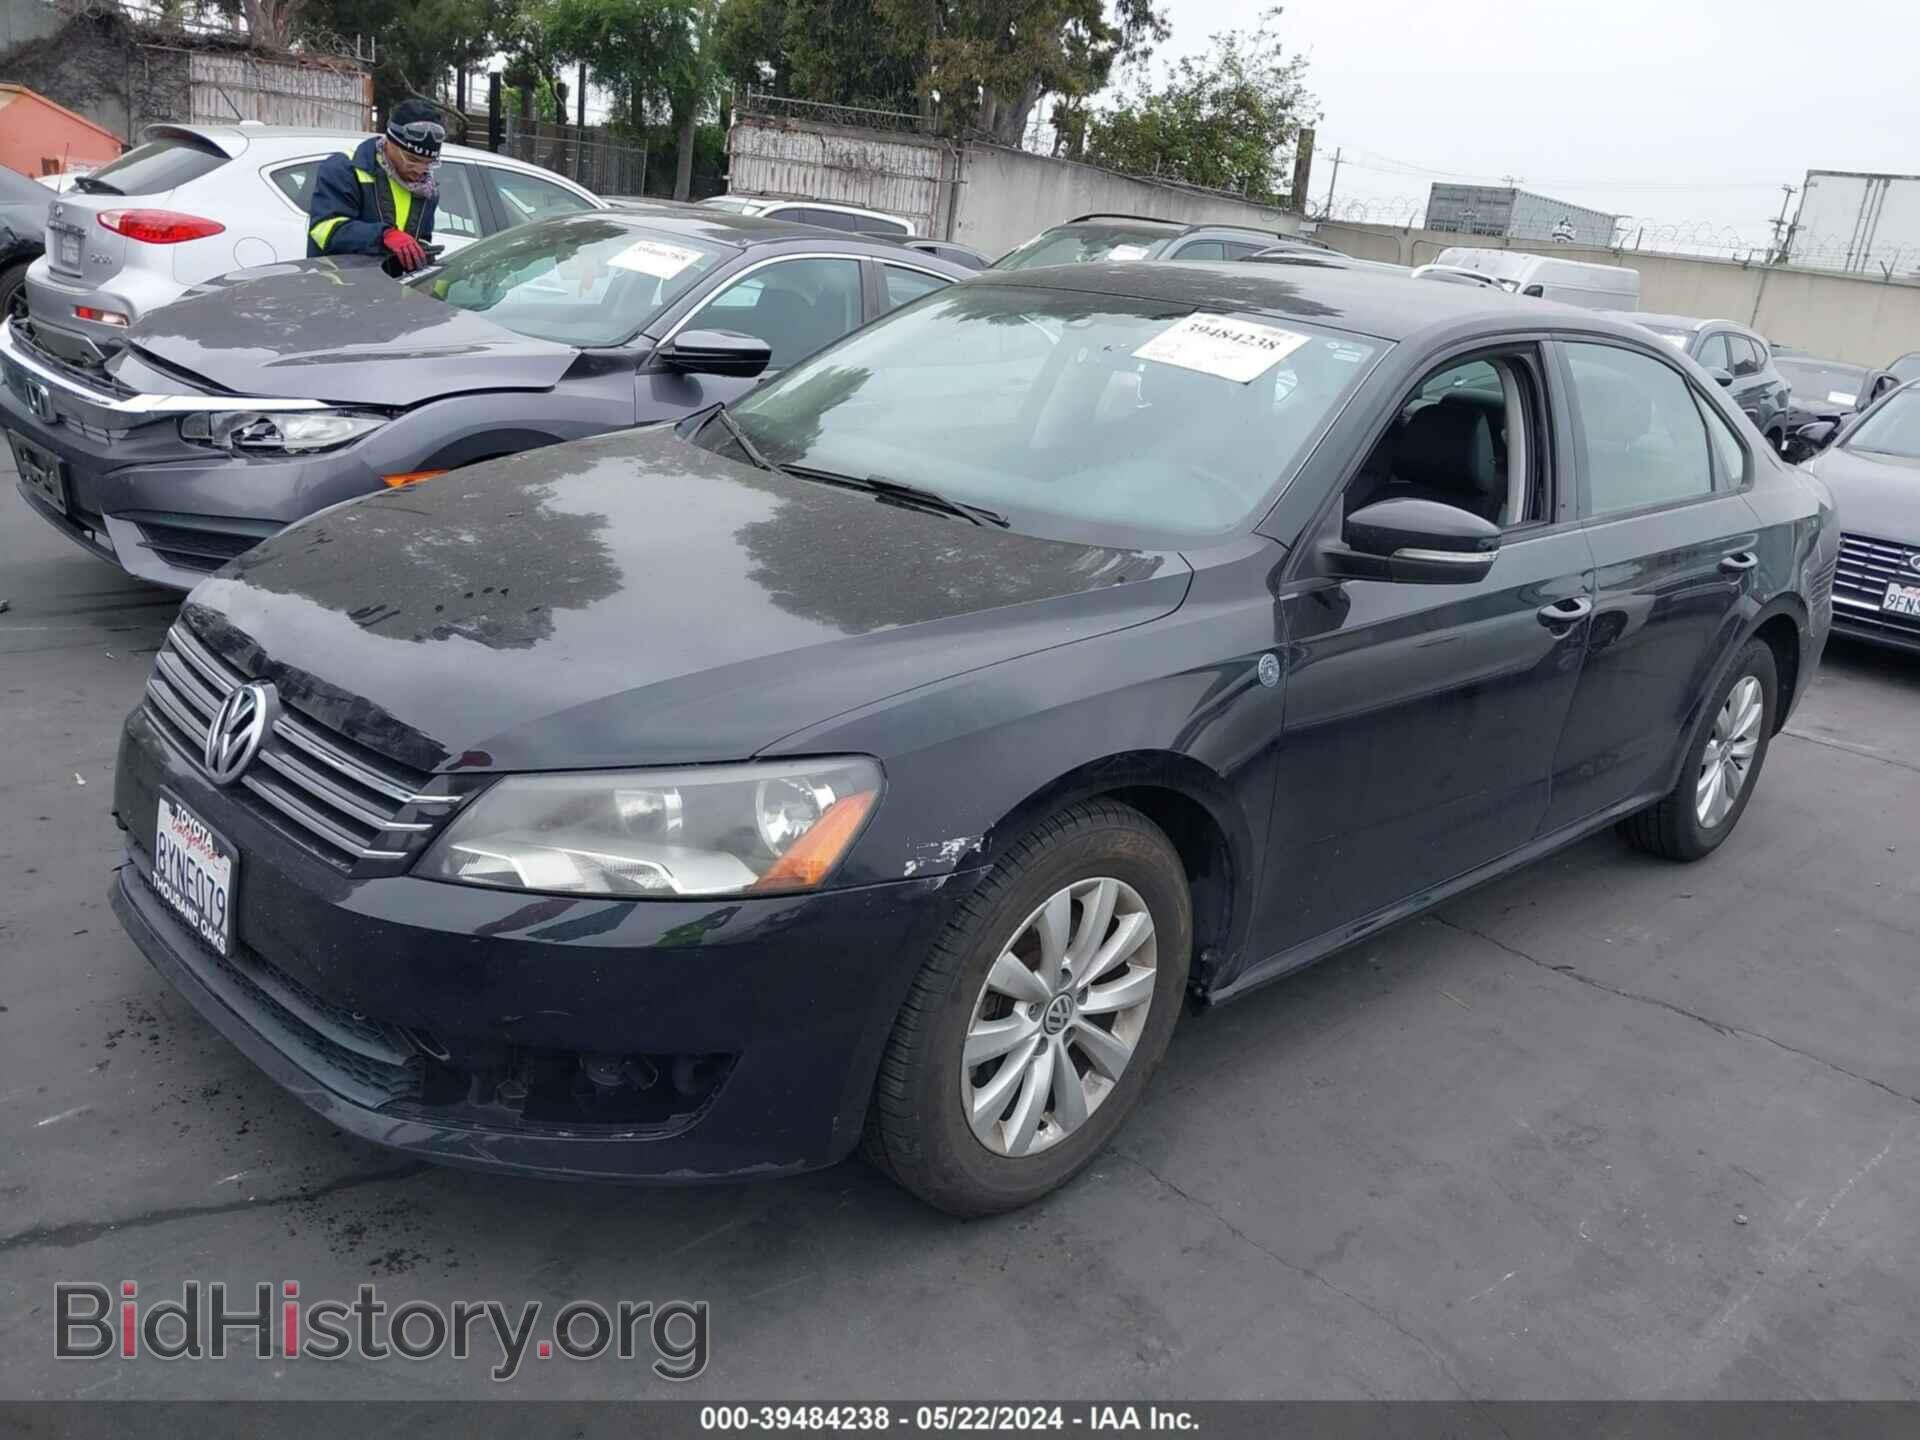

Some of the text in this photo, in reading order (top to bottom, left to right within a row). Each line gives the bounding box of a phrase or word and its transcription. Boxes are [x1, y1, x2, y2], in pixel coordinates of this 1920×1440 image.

[1182, 323, 1281, 350] 39484238
[175, 803, 214, 848] TOYOTA
[152, 869, 226, 955] THOUSAND OAKS
[157, 831, 226, 929] 8YNE079
